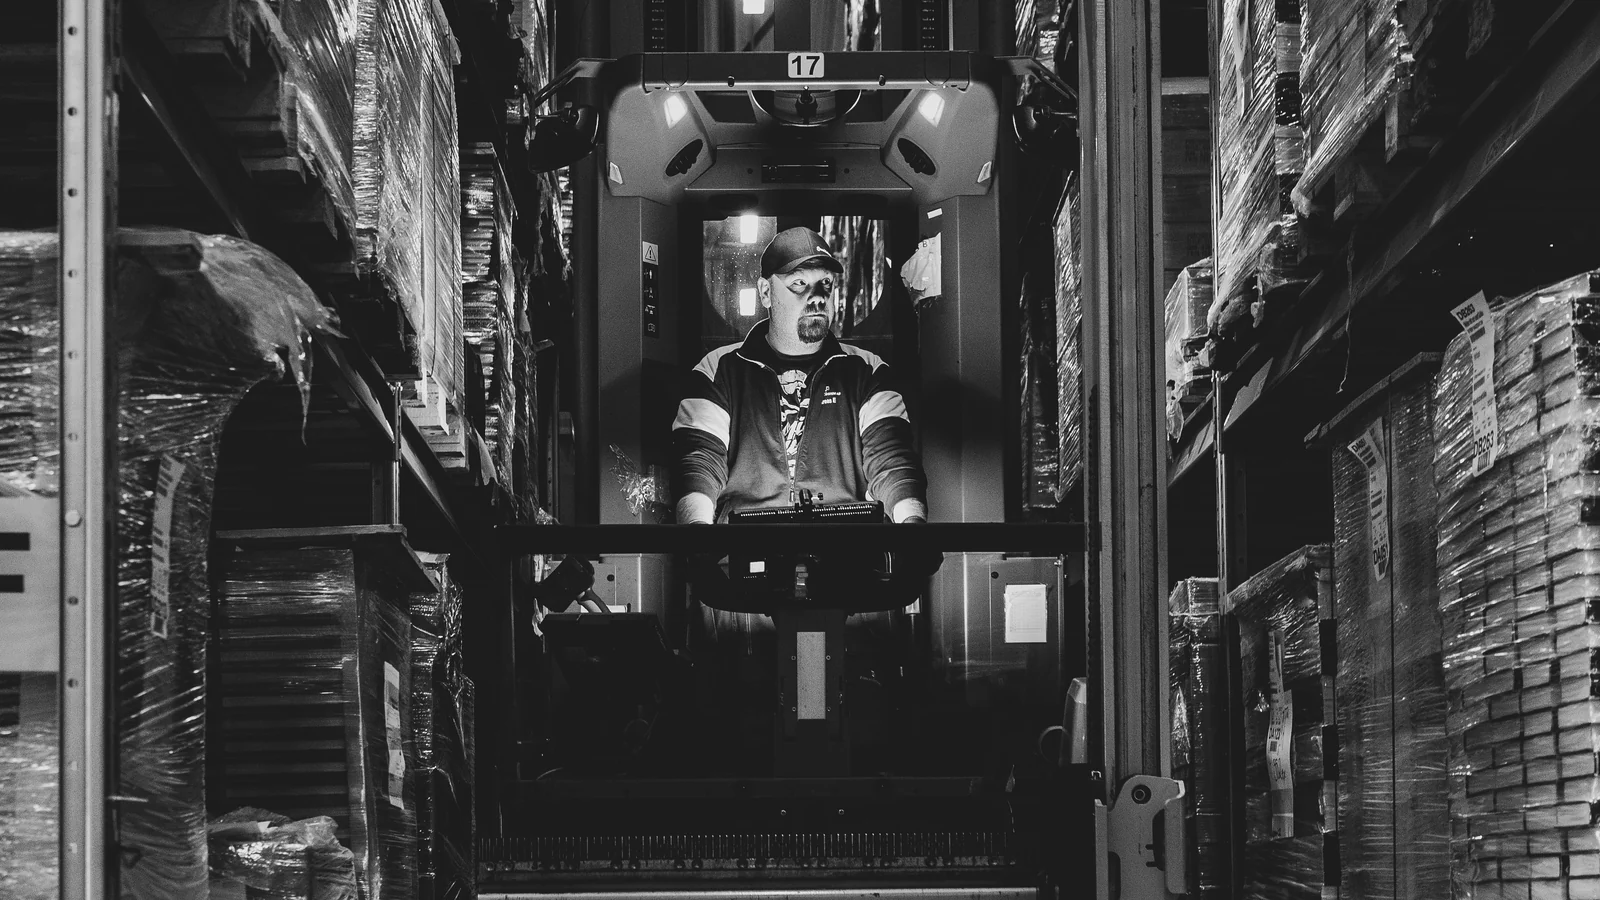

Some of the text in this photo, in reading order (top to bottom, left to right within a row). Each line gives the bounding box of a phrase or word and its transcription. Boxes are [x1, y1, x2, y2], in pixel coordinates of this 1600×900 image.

[792, 55, 820, 75] 17
[1456, 303, 1476, 321] DB263
[1473, 430, 1495, 458] DB263
